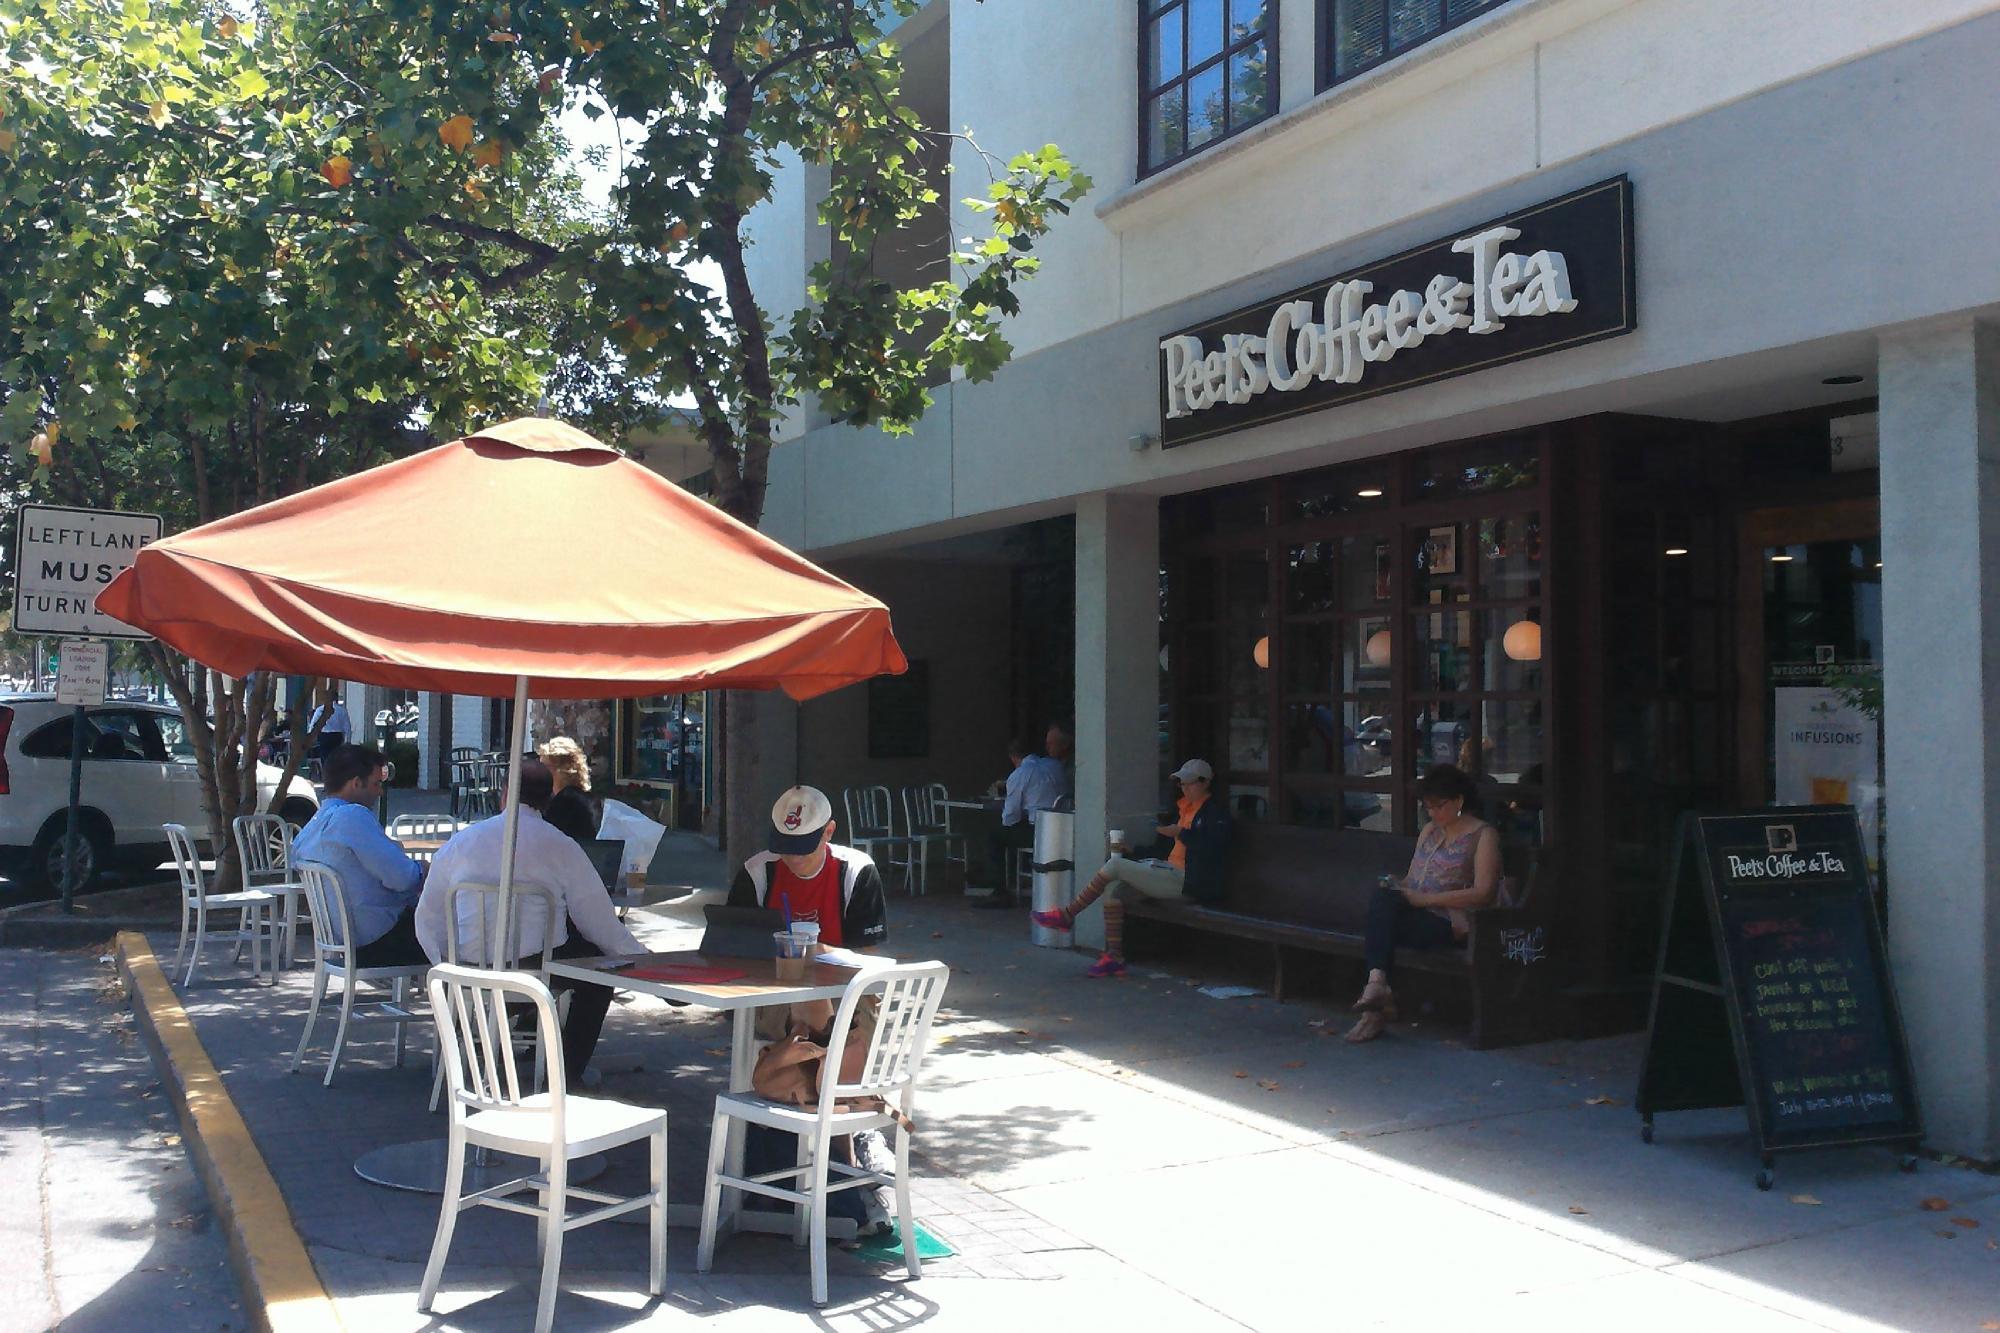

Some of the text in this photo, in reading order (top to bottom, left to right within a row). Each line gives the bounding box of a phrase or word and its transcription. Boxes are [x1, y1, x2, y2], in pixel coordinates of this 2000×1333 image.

[1160, 225, 1579, 420] Peet's Coffee & Tea
[28, 526, 84, 547] LEFT
[41, 560, 134, 583] MUS
[23, 595, 87, 615] TURN
[1791, 731, 1863, 745] INFUSIONS
[1727, 851, 1846, 879] Peet's Coffee & Tea
